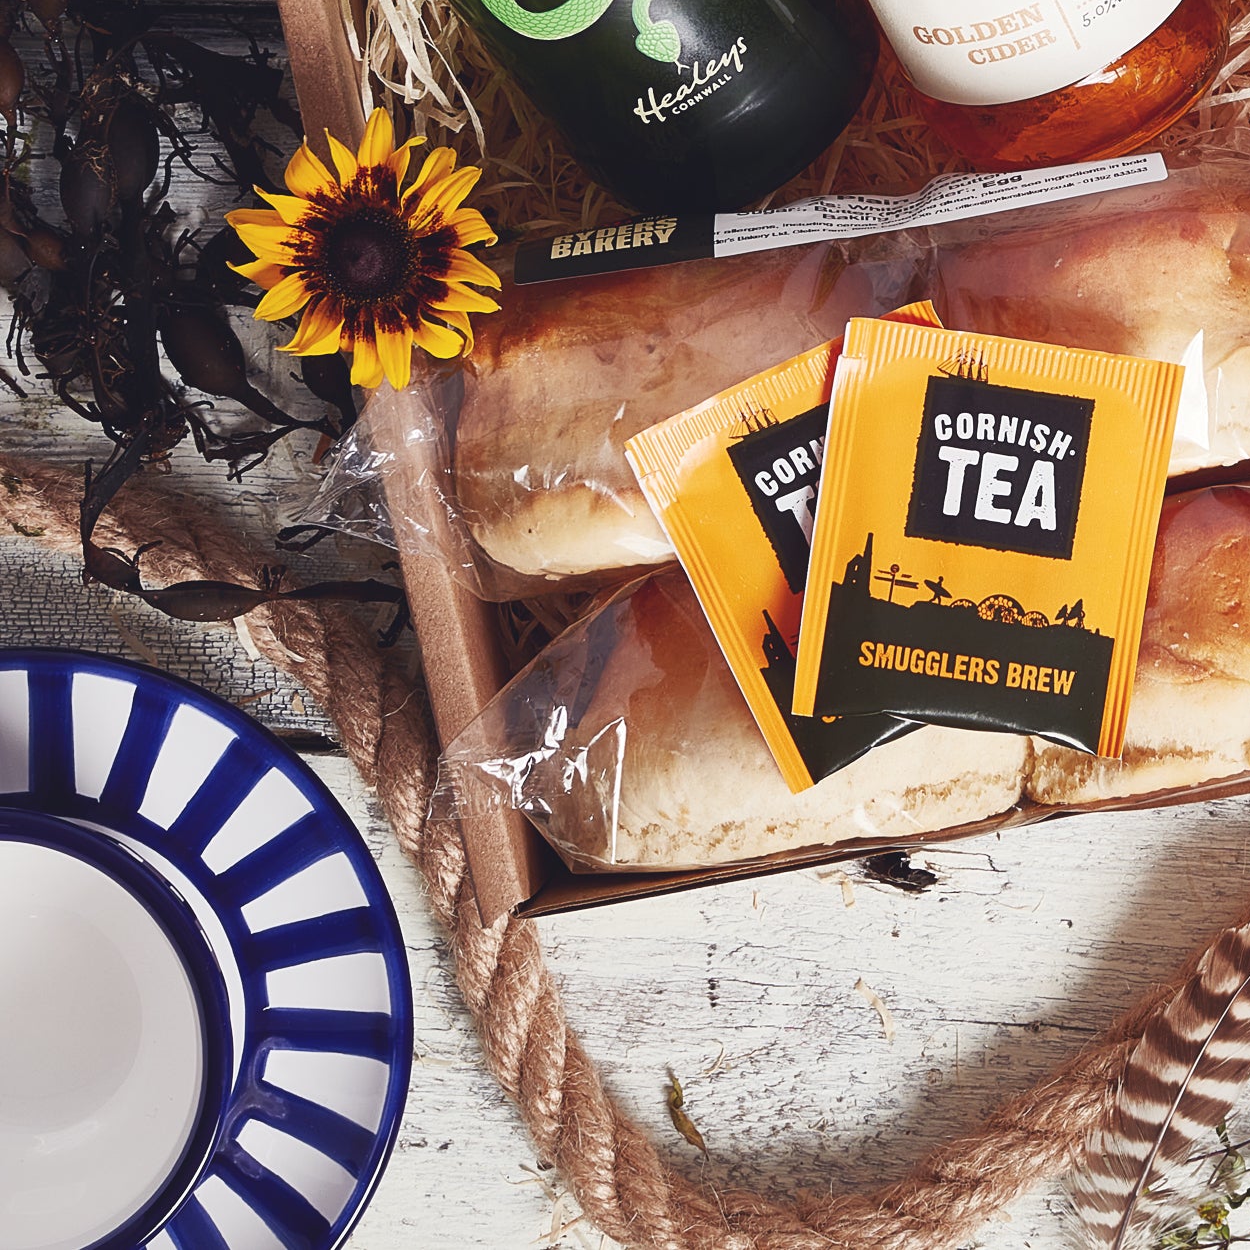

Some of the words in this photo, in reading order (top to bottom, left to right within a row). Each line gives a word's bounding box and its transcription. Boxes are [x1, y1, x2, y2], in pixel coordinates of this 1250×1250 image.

[911, 2, 1045, 46] GOLDEN
[967, 28, 1058, 66] CIDER
[634, 36, 748, 124] Healeys
[671, 73, 732, 116] CORNWALL
[982, 174, 1023, 188] Egg
[1021, 180, 1042, 188] see
[1044, 166, 1107, 182] ingredients
[1121, 157, 1148, 166] bold
[550, 227, 677, 260] BAKERY
[553, 217, 679, 245] RYDERS
[754, 435, 827, 497] CORN
[938, 445, 1057, 531] TEA
[858, 641, 1000, 686] SMUGGLERS
[1005, 662, 1076, 697] BREW
